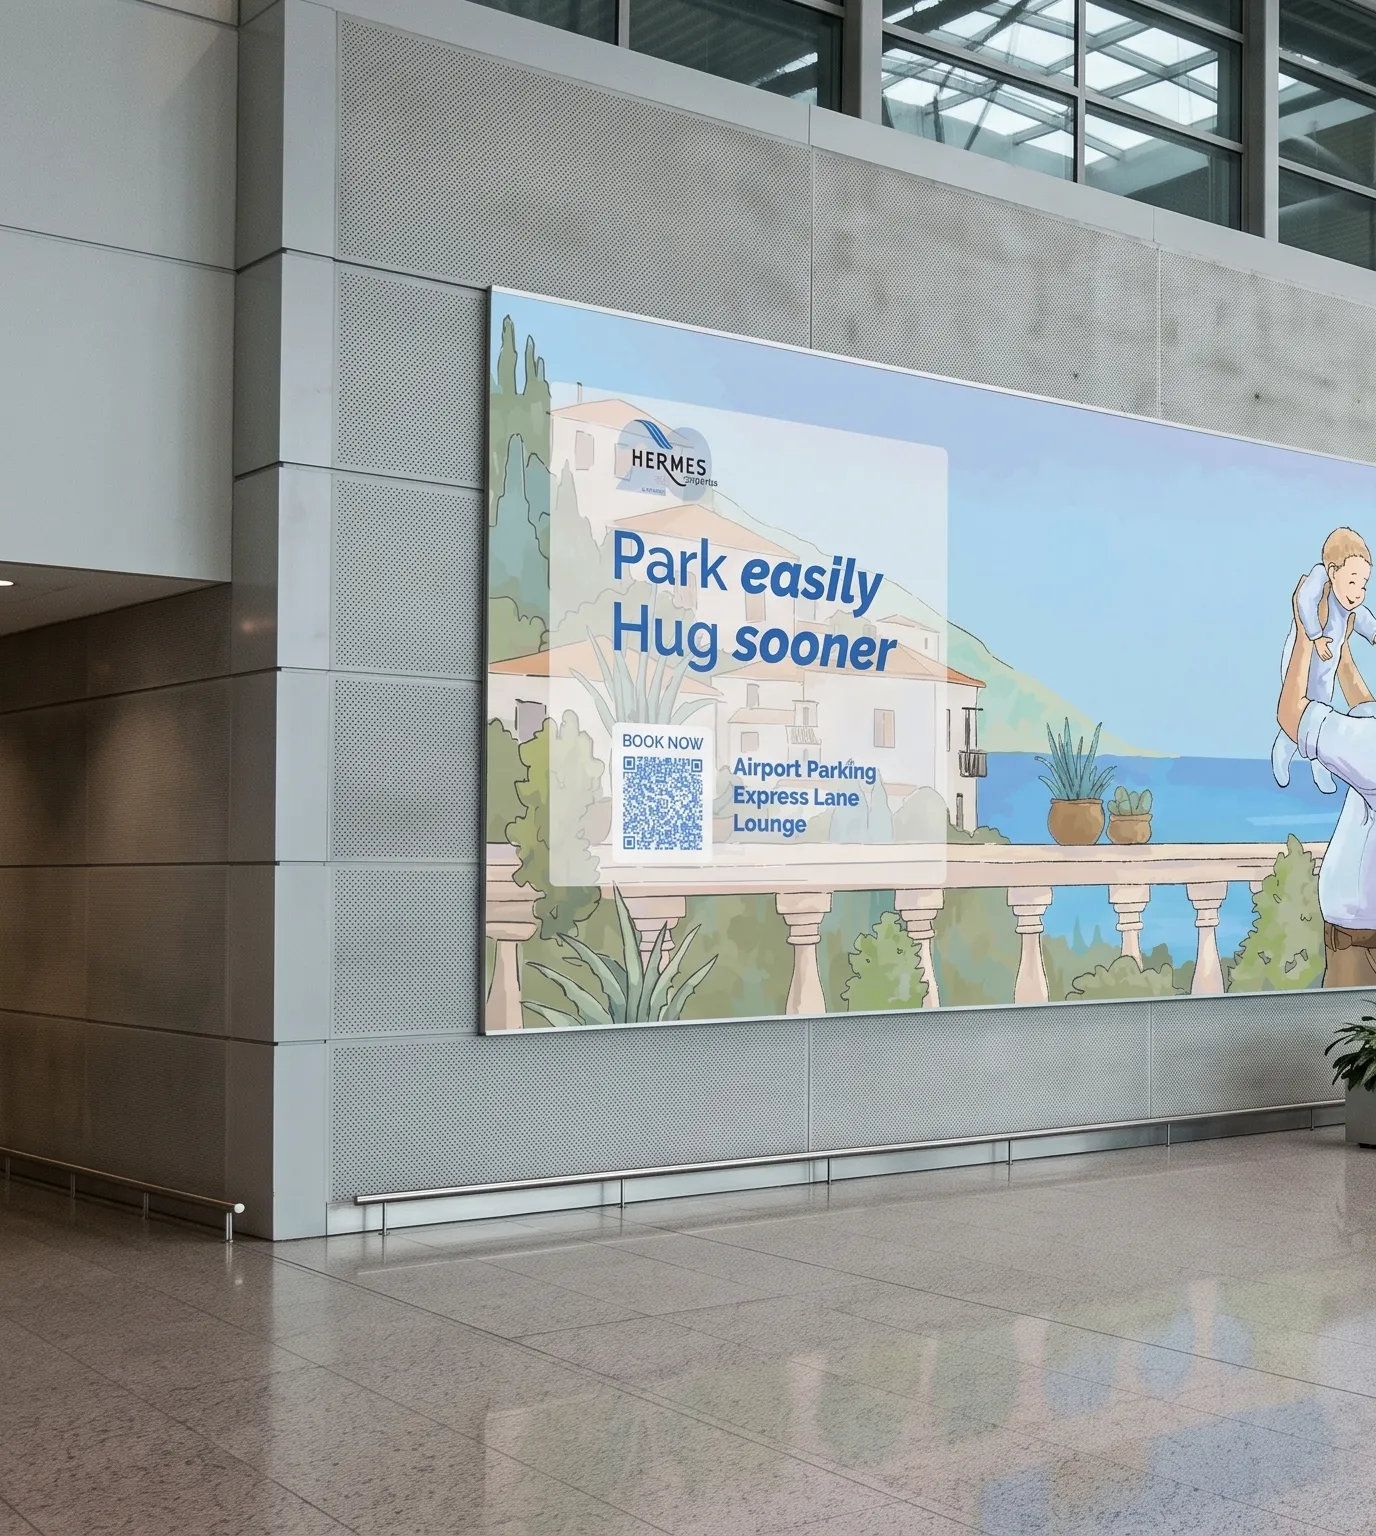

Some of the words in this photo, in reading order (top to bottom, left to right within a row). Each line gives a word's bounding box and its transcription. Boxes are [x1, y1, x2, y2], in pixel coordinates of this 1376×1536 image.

[632, 449, 706, 487] HERMES
[613, 530, 727, 591] Park
[740, 555, 884, 618] easily
[613, 602, 718, 673] Hug
[732, 625, 897, 672] sooner
[623, 734, 664, 749] BOOK
[668, 736, 704, 751] NOW
[733, 757, 802, 782] Airport
[807, 760, 877, 785] Parking
[733, 785, 809, 809] Express
[814, 788, 860, 807] Lane
[733, 813, 807, 838] Lounge
